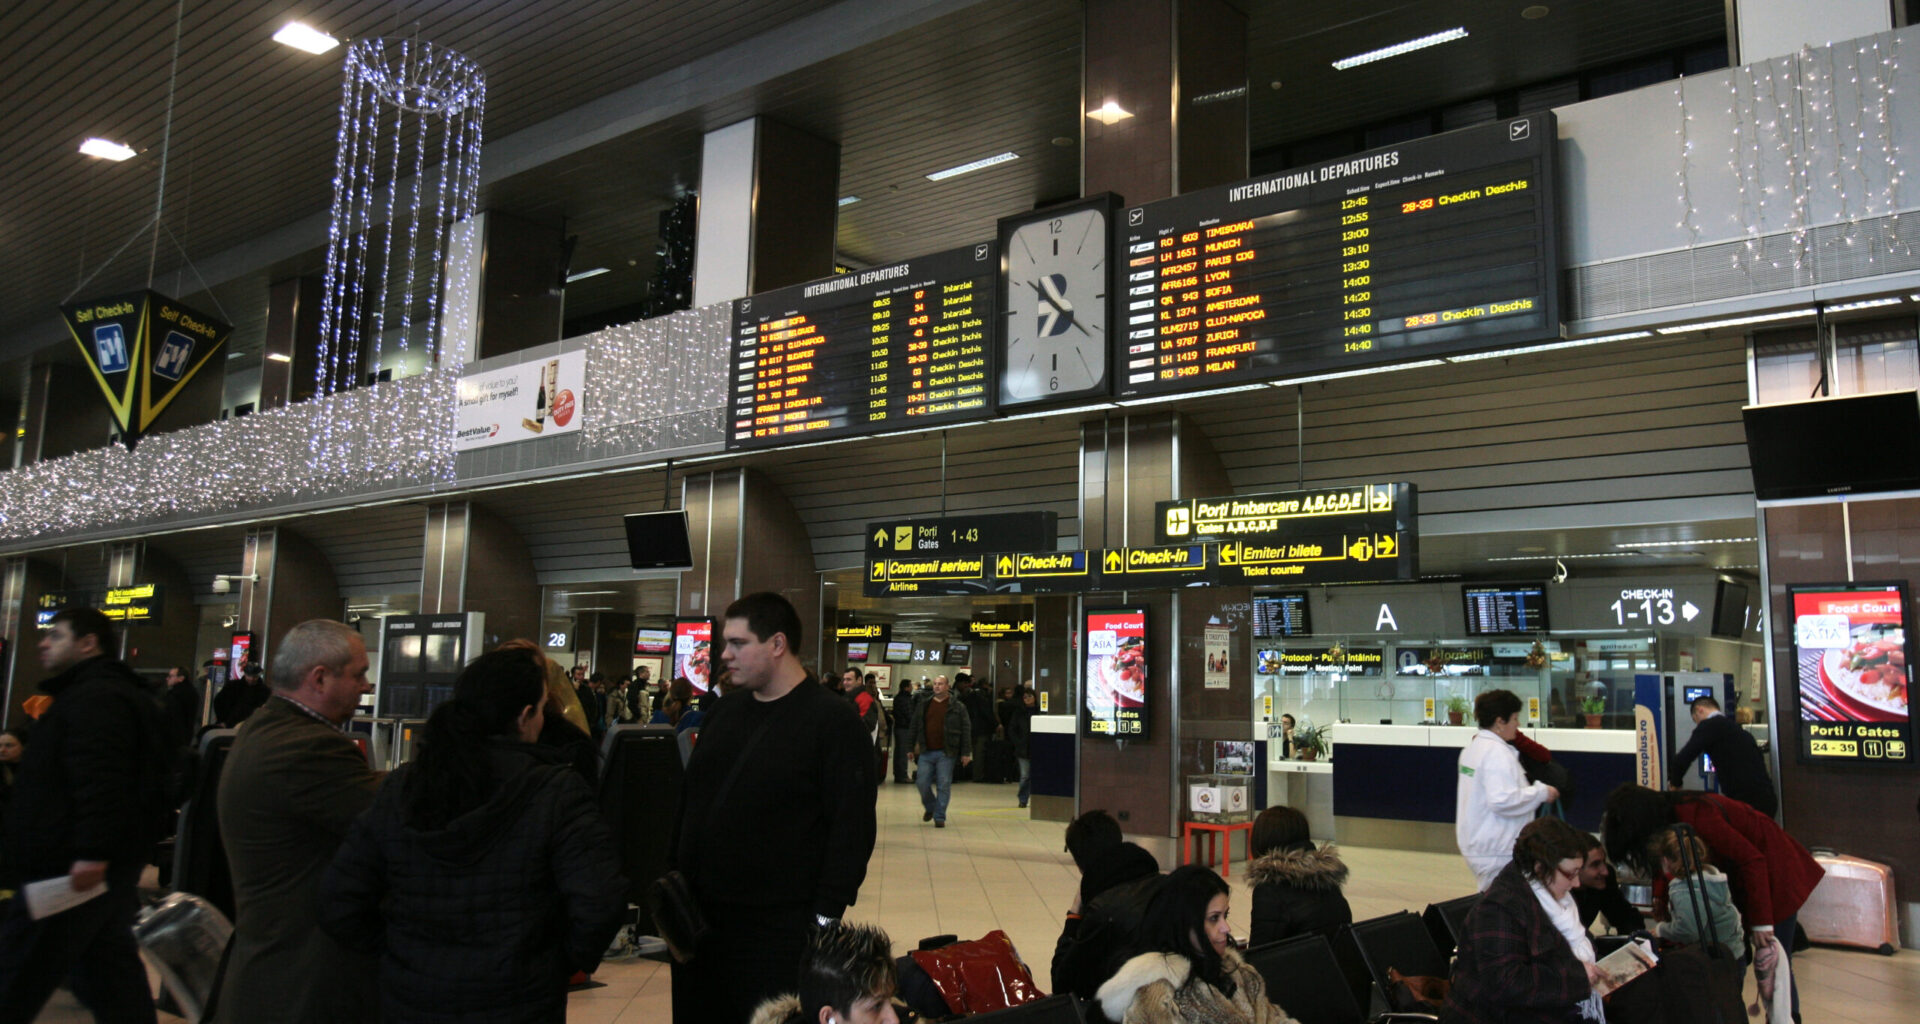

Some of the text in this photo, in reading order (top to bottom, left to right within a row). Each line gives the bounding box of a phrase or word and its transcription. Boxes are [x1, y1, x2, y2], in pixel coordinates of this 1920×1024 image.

[1230, 152, 1399, 202] INTERNATIONAL DEPARTURES
[1049, 220, 1062, 234] 12
[1160, 180, 1527, 262] LH 1651 MUNICH 12:55 28-33 Checkin Deschis
[1160, 196, 1368, 248] RO 603 TIMISOARA 12:45
[1162, 228, 1368, 276] AFR2457 PARIS CDG 13:00
[1162, 244, 1369, 291] AFR6166 LYON 13:10
[804, 264, 909, 298] INTERNATIONAL DEPARTURES
[1162, 260, 1370, 306] QR 943 SOFIA 13:30
[915, 290, 924, 299] 07
[1161, 276, 1370, 320] KL 1374 AMSTERDAM 14:00
[76, 309, 94, 322] Self
[160, 306, 179, 322] Self
[1161, 292, 1370, 335] KLM2719 CLUJ-NAPOCA 14:20
[1161, 300, 1532, 364] LH 1419 FRANKFURT 14:40 28-33 Checkin Deschis
[1177, 336, 1198, 347] 9787
[1206, 330, 1238, 342] ZURICH
[1344, 308, 1370, 320] 14:30
[871, 361, 888, 370] 11:05
[1161, 340, 1371, 379] RO 9409 MILAN 14:40
[871, 374, 887, 382] 11:35
[1050, 377, 1058, 390] 6
[785, 399, 808, 409] LONDON
[870, 386, 887, 395] 11:45
[870, 399, 886, 408] 12:05
[870, 412, 886, 421] 12:20
[1232, 500, 1299, 516] îmbarcare
[1302, 493, 1361, 513] A,B,C,D,E
[1197, 519, 1277, 534] Gates A,B,C,D,E
[952, 529, 978, 543] 1 43
[918, 539, 939, 549] Gates
[1130, 548, 1188, 564] Check-in
[1243, 544, 1322, 560] Emiteri bilete
[890, 560, 980, 576] Companii aeriene
[1020, 553, 1072, 570] Check-in
[1242, 564, 1304, 576] Ticket counter
[890, 582, 918, 592] Airlines
[1621, 589, 1673, 600] CHECK-IN
[1611, 600, 1675, 624] 1-13
[1827, 602, 1899, 614] Food Court
[1376, 604, 1398, 631] A
[548, 633, 566, 647] 28
[1806, 628, 1840, 640] ASIA
[1093, 640, 1112, 649] ASIA
[914, 650, 940, 662] 33 34
[1281, 654, 1312, 662] Protocol
[1322, 654, 1344, 662] Put
[1315, 665, 1342, 673] Meeting
[1810, 725, 1899, 737] Porti / Gates
[1813, 742, 1855, 752] 24 39
